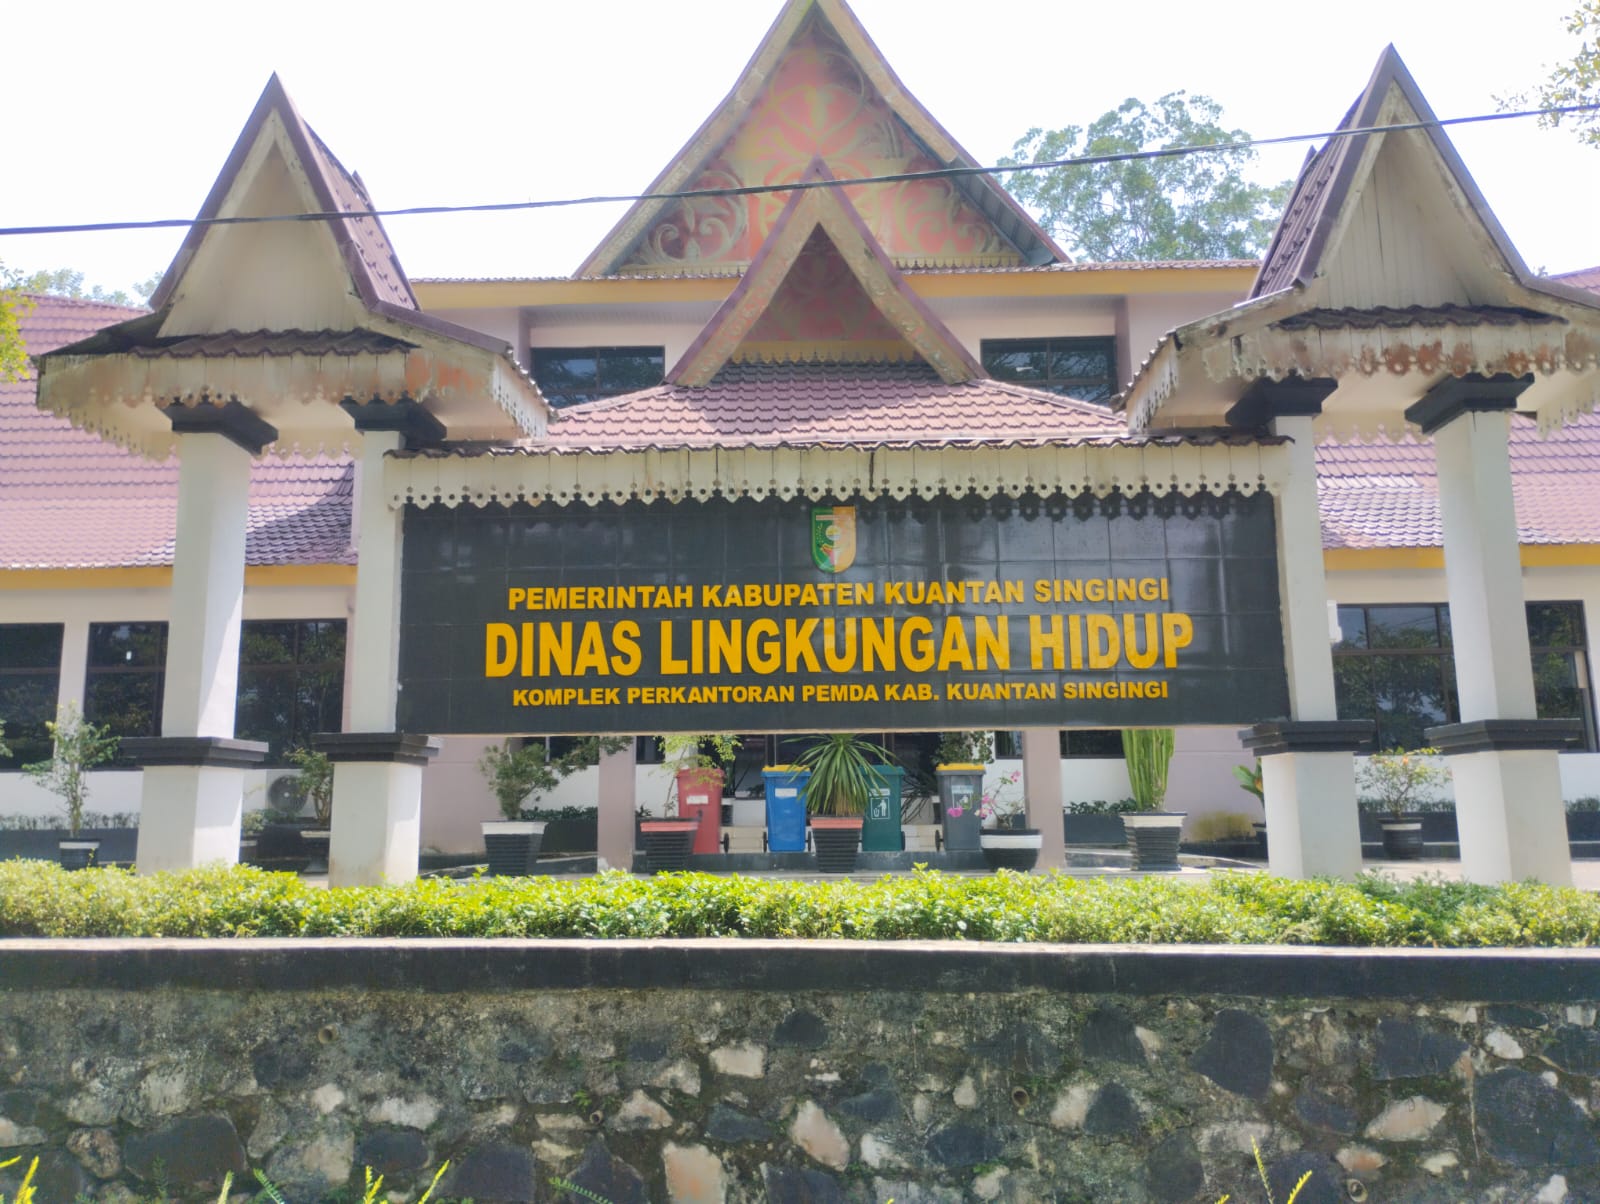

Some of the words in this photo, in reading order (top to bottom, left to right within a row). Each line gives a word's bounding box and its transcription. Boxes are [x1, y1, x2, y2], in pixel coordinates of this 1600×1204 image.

[508, 585, 694, 610] PEMERINTAH
[702, 582, 875, 607] KABUPATEN
[883, 580, 1024, 605] KUANTAN
[1033, 578, 1169, 603] SINGINGI
[484, 619, 643, 677] DINAS
[660, 614, 1011, 675] LINGKUNGAN
[1028, 612, 1194, 670] HIDUP
[512, 687, 621, 706] KOMPLEK
[626, 685, 795, 705] PERKANTORAN
[801, 683, 880, 702] PEMDA
[884, 683, 940, 701] KAB.
[946, 682, 1057, 700] KUANTAN
[1062, 680, 1169, 699] SINGINGI
